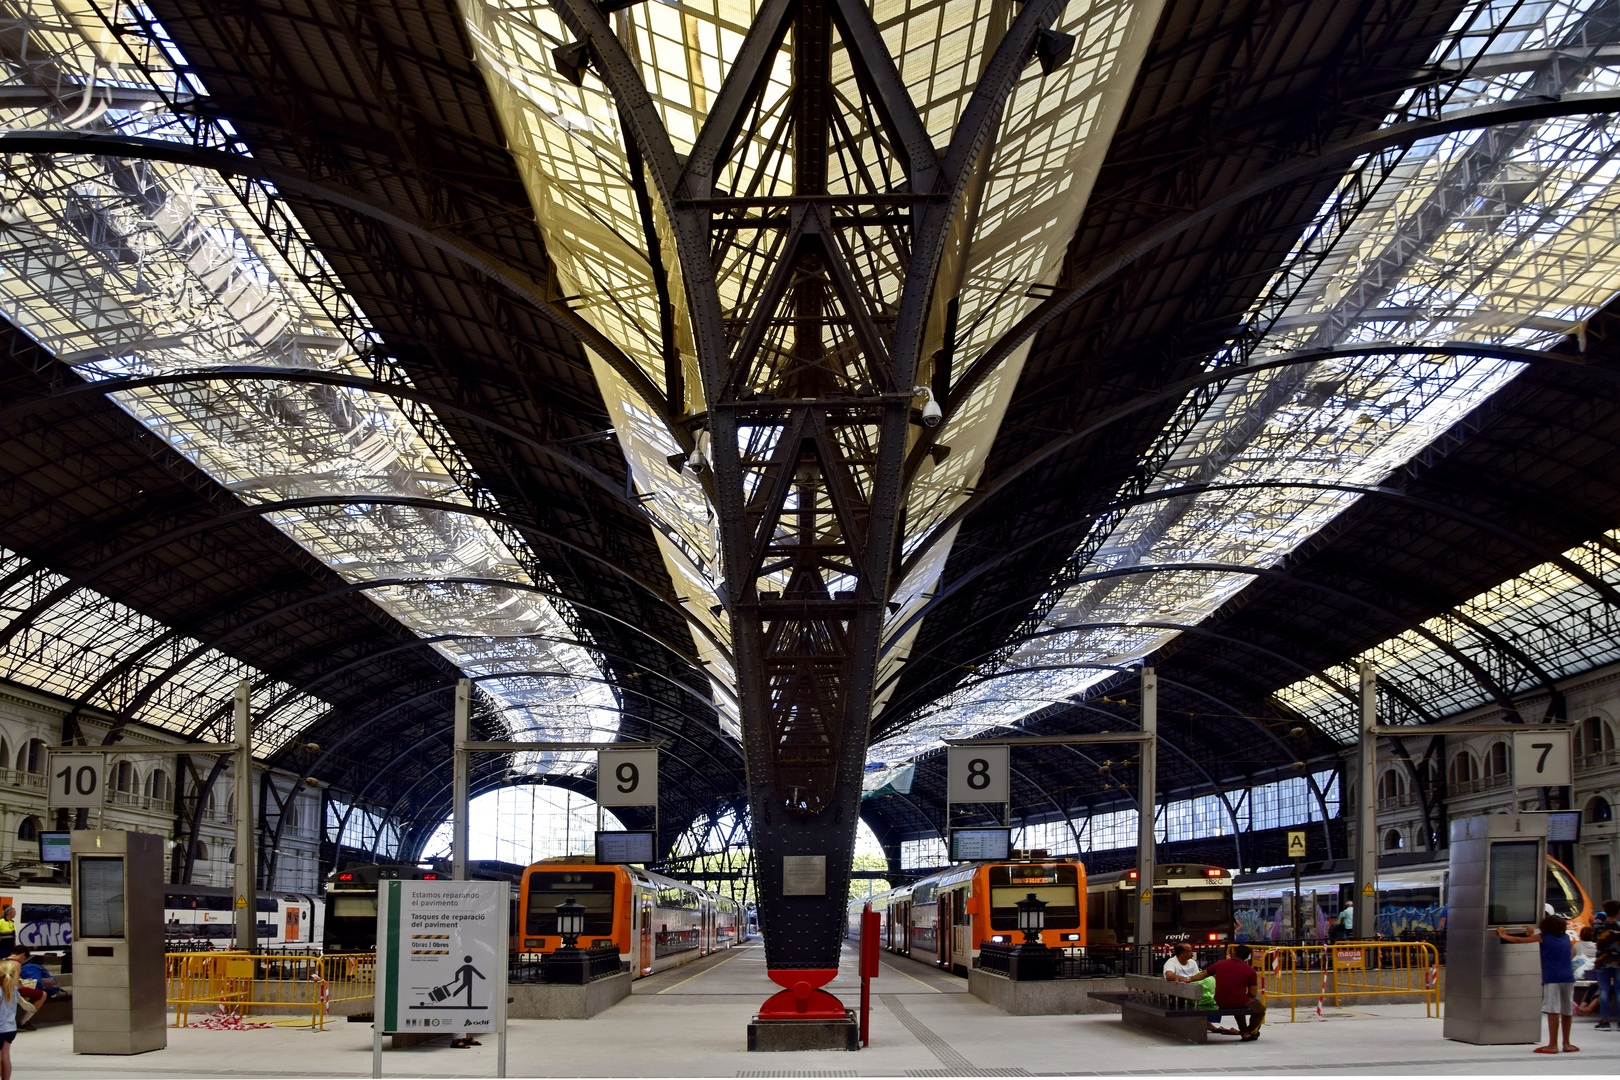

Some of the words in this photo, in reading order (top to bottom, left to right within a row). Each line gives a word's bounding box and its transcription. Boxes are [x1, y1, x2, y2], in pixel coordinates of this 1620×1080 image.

[1531, 743, 1553, 773] 7
[56, 765, 97, 795] 10
[616, 762, 639, 793] 9
[967, 758, 990, 790] 8
[1290, 835, 1303, 848] A
[412, 891, 441, 899] Estamos
[443, 892, 480, 900] reparando
[411, 913, 439, 921] Tasques
[452, 913, 486, 921] reparació
[424, 921, 458, 929] paviment
[1165, 932, 1190, 941] renfe
